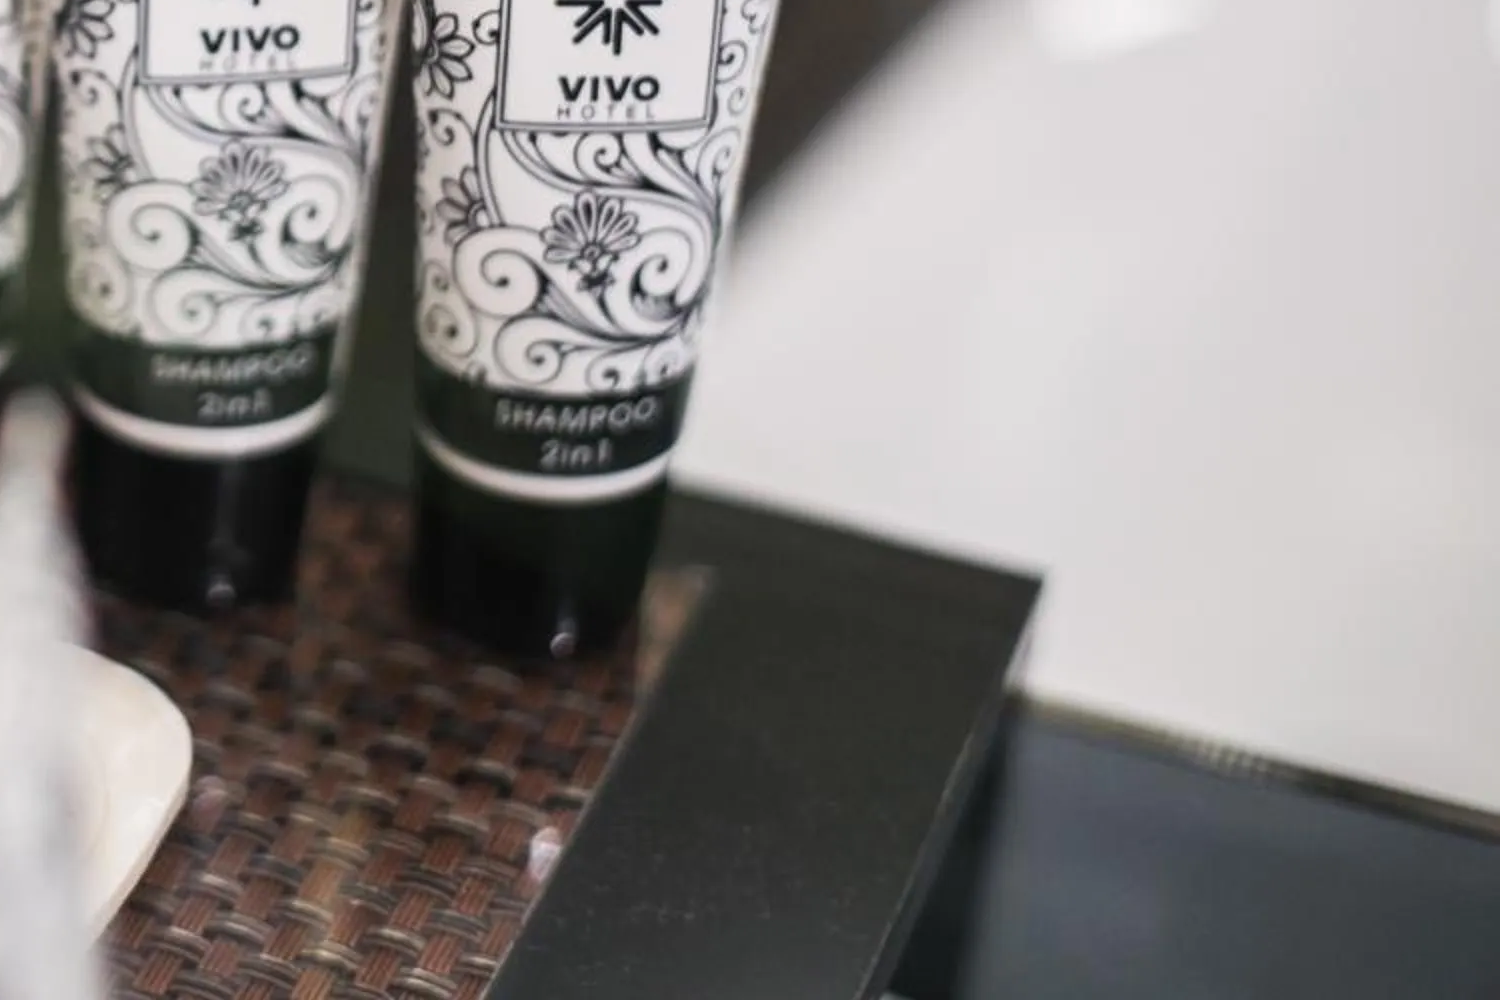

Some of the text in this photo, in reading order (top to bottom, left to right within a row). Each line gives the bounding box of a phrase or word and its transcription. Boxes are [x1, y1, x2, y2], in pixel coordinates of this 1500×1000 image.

[202, 25, 300, 53] VIVO
[558, 75, 660, 102] VIVO
[557, 104, 655, 121] HOTEL
[151, 349, 312, 386] SHAMPOO
[495, 398, 656, 434] SHAMPOO
